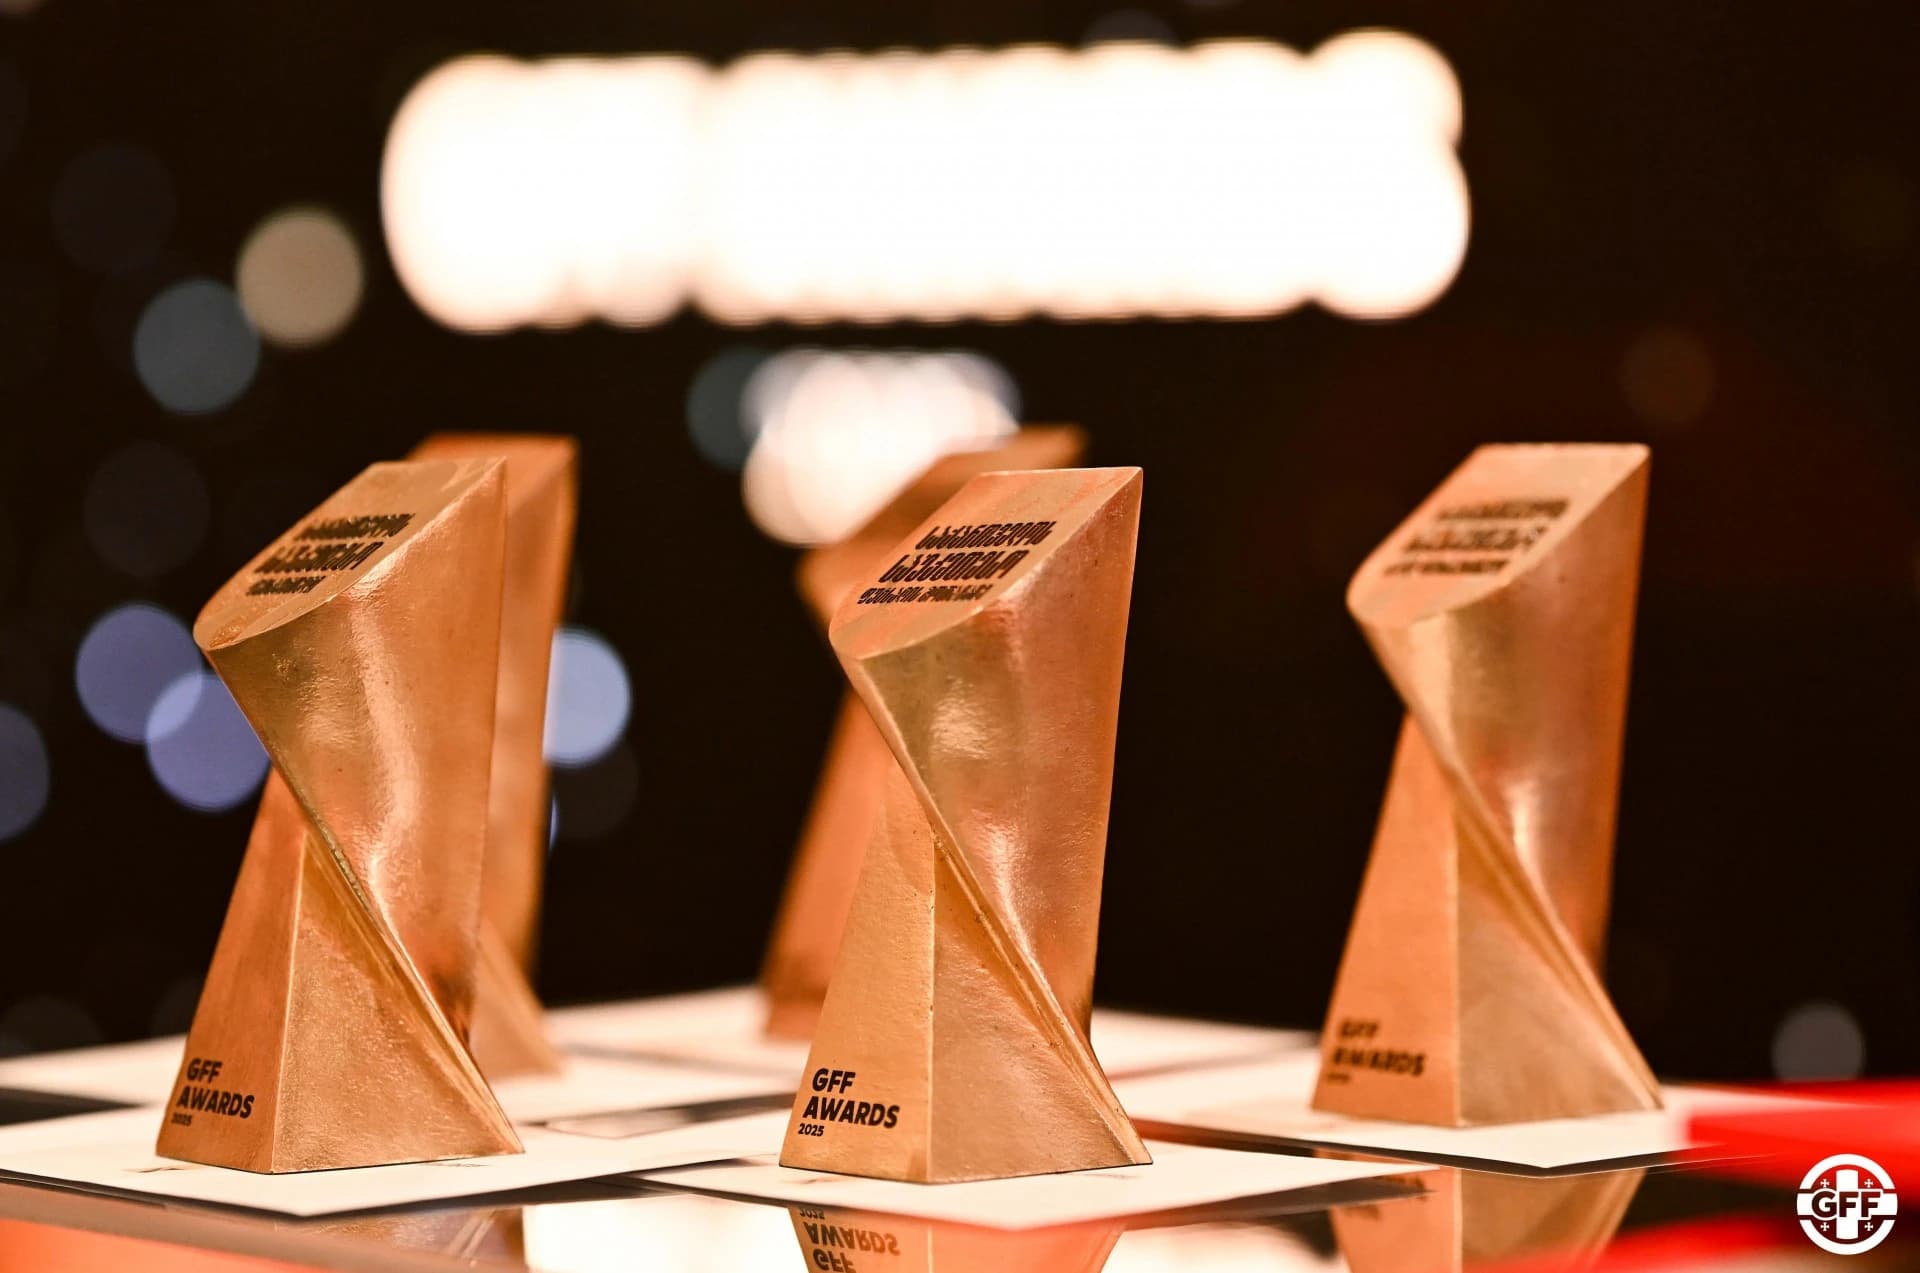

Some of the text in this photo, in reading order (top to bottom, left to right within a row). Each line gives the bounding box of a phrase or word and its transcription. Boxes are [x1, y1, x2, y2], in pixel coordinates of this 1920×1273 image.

[187, 1058, 222, 1083] GFF
[812, 1068, 856, 1093] GFF
[176, 1086, 255, 1119] AWARDS
[802, 1096, 900, 1128] AWARDS
[798, 1123, 824, 1136] 2025
